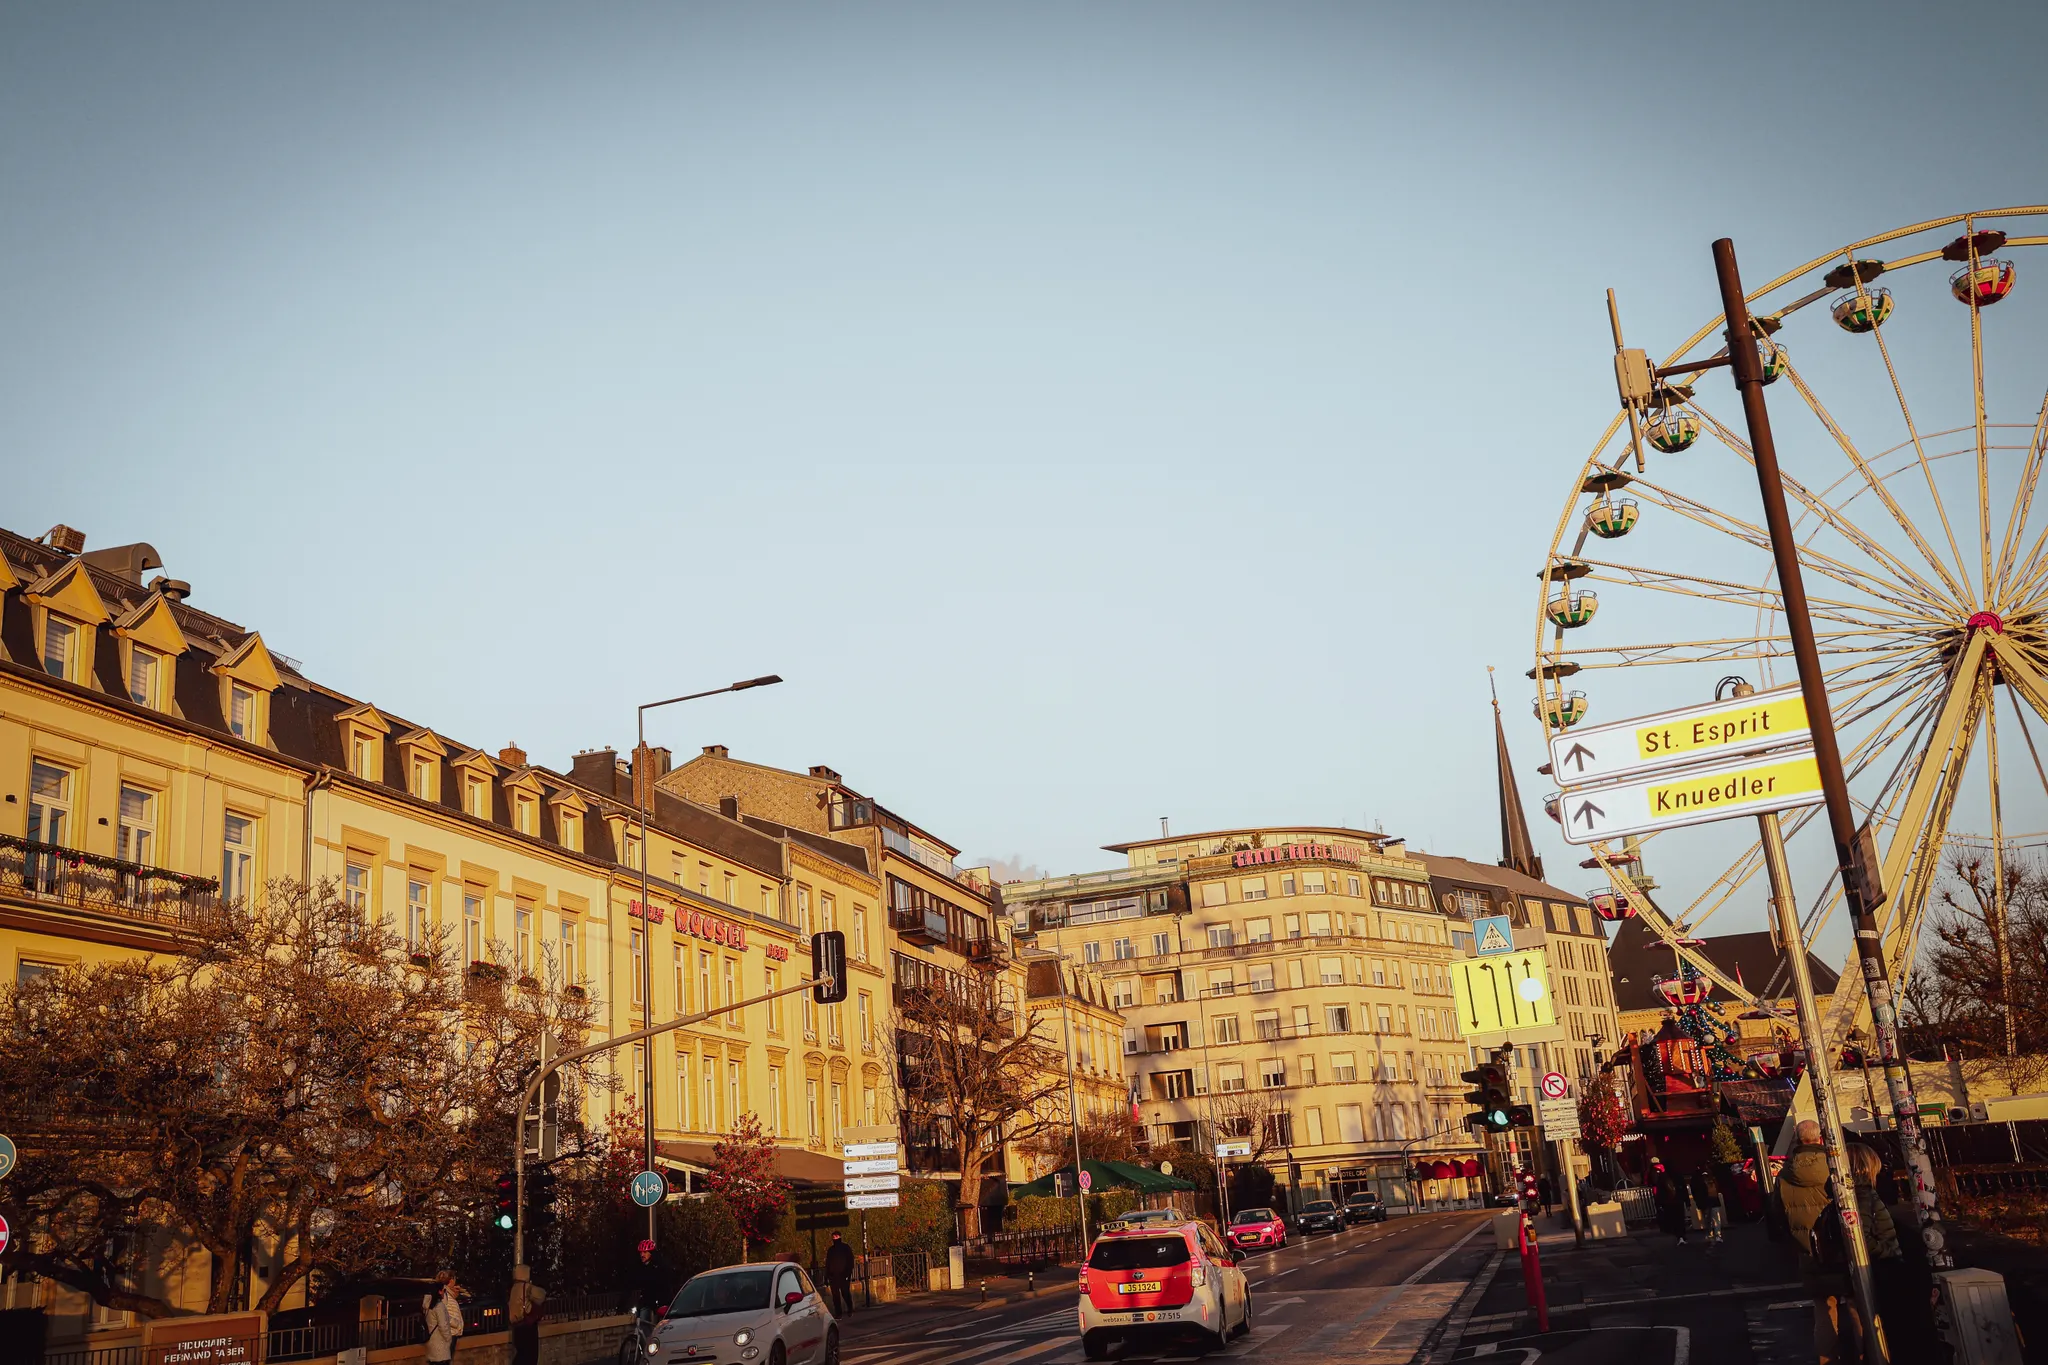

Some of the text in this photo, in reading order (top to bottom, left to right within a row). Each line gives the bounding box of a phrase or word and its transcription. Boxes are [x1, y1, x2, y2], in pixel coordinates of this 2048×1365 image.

[1645, 711, 1770, 753] St. Esprit
[1657, 776, 1776, 811] Knuedler
[1236, 847, 1282, 867] GRAND
[1288, 843, 1331, 859] HOTEL
[674, 906, 749, 951] MOUSEL
[1106, 1221, 1124, 1230] TAXI
